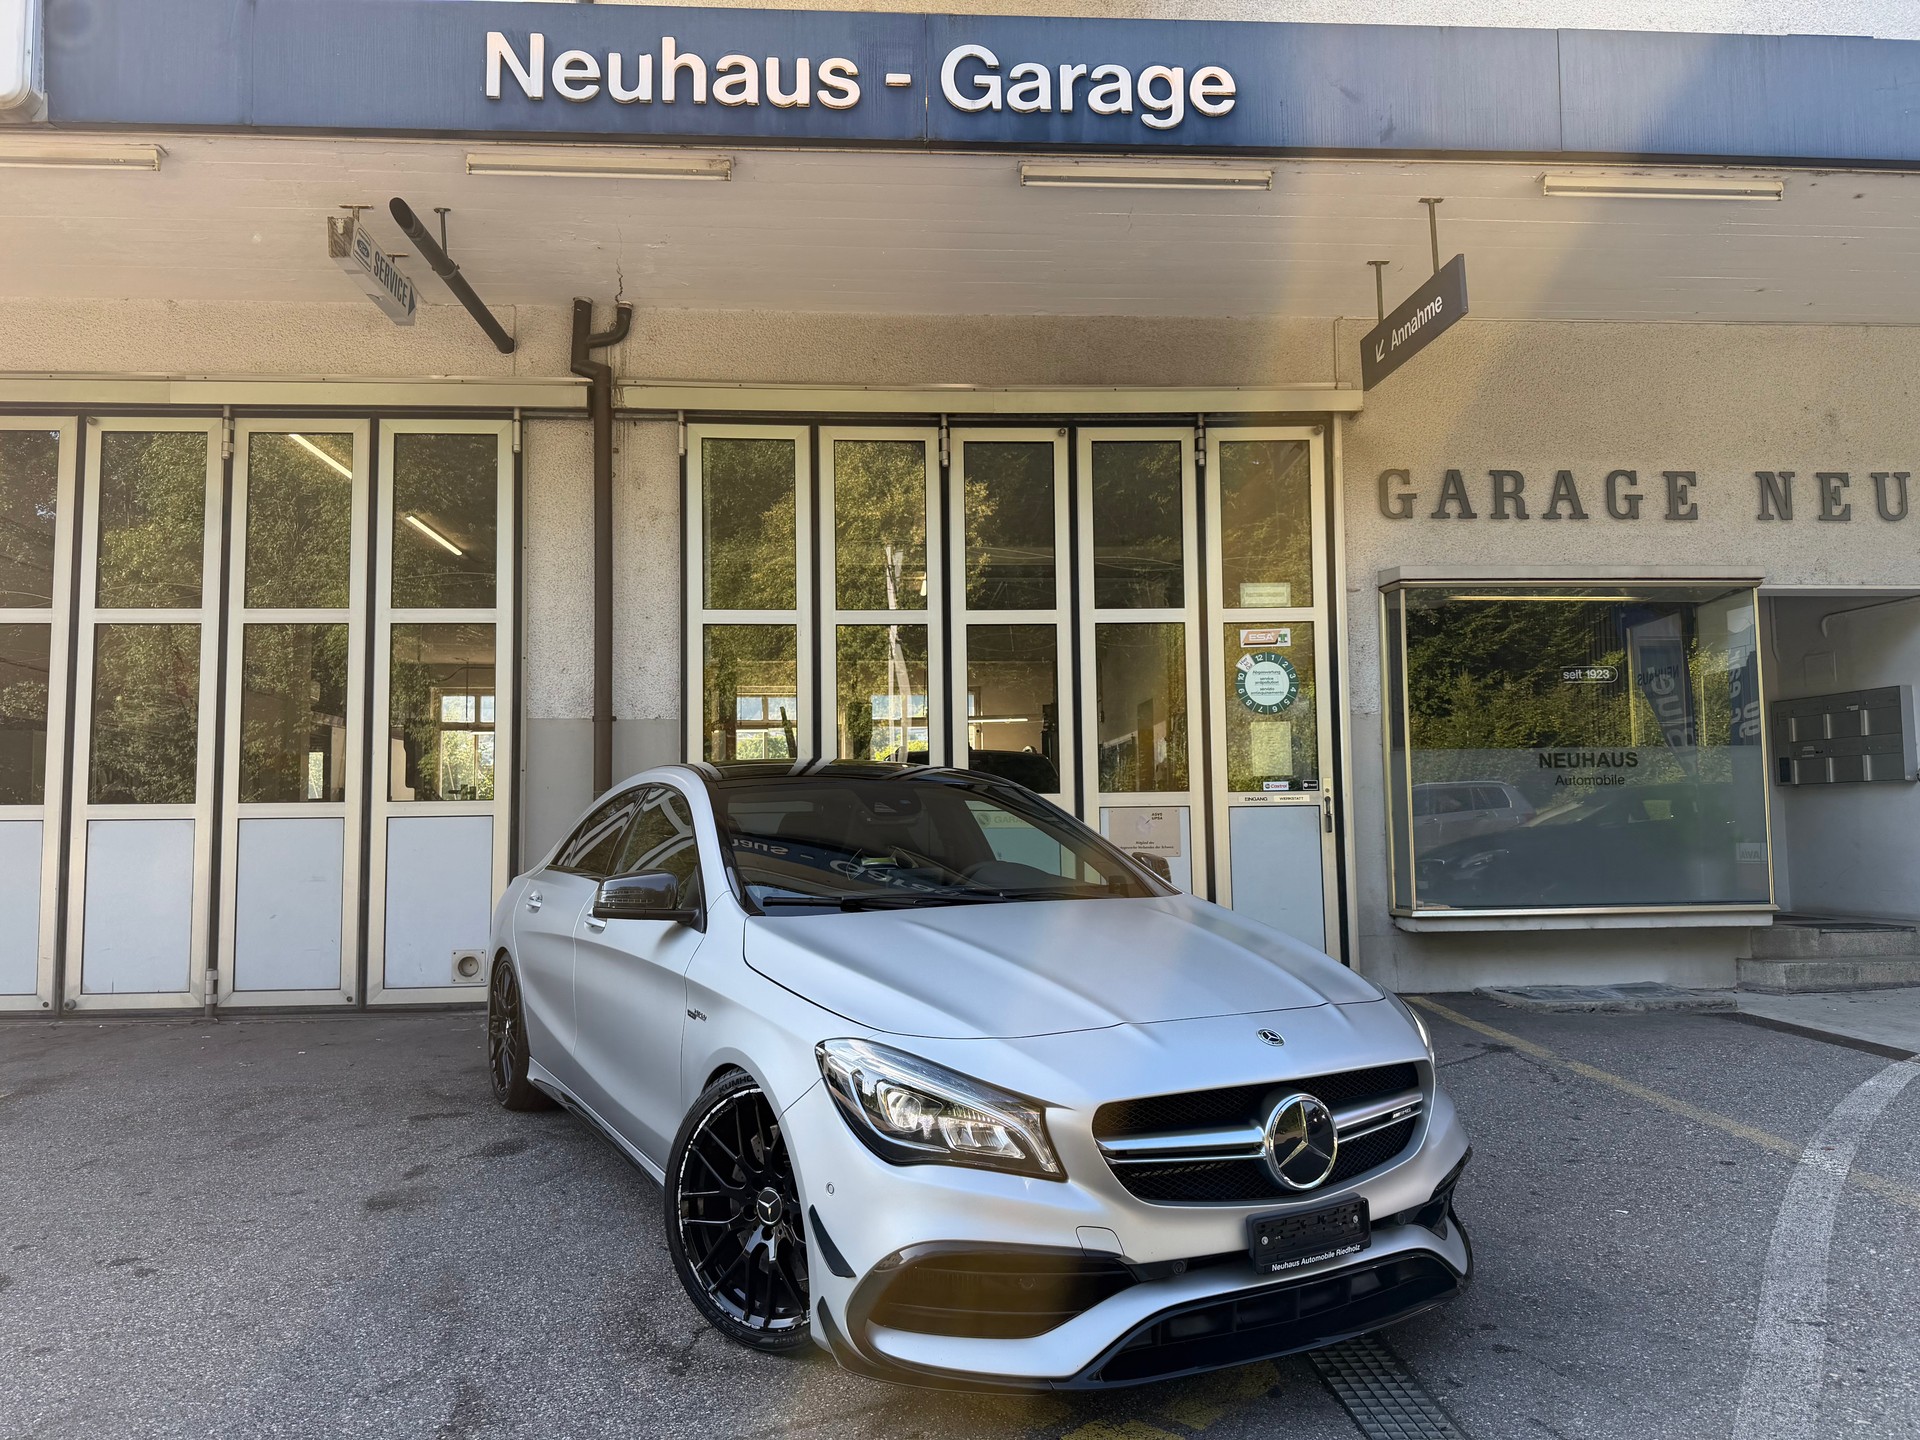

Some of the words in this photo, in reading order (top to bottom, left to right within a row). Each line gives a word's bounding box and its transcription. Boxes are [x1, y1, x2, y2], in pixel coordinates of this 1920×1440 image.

[486, 31, 861, 110] Neuhaus
[940, 44, 1236, 130] Garage
[373, 251, 408, 308] SERVICE
[1391, 296, 1443, 351] Annahme
[1378, 468, 1699, 521] GARAGE
[1755, 471, 1911, 521] NEU
[1237, 673, 1245, 681] 10
[1563, 669, 1582, 680] seit
[1585, 669, 1610, 679] 1923
[1539, 752, 1638, 768] NEUHAUS
[1555, 775, 1625, 786] Automobile
[719, 1075, 753, 1093] KUMHO
[1272, 1260, 1300, 1272] Neuhaus
[1301, 1252, 1335, 1265] Automobile
[1336, 1244, 1361, 1256] Riedholz
